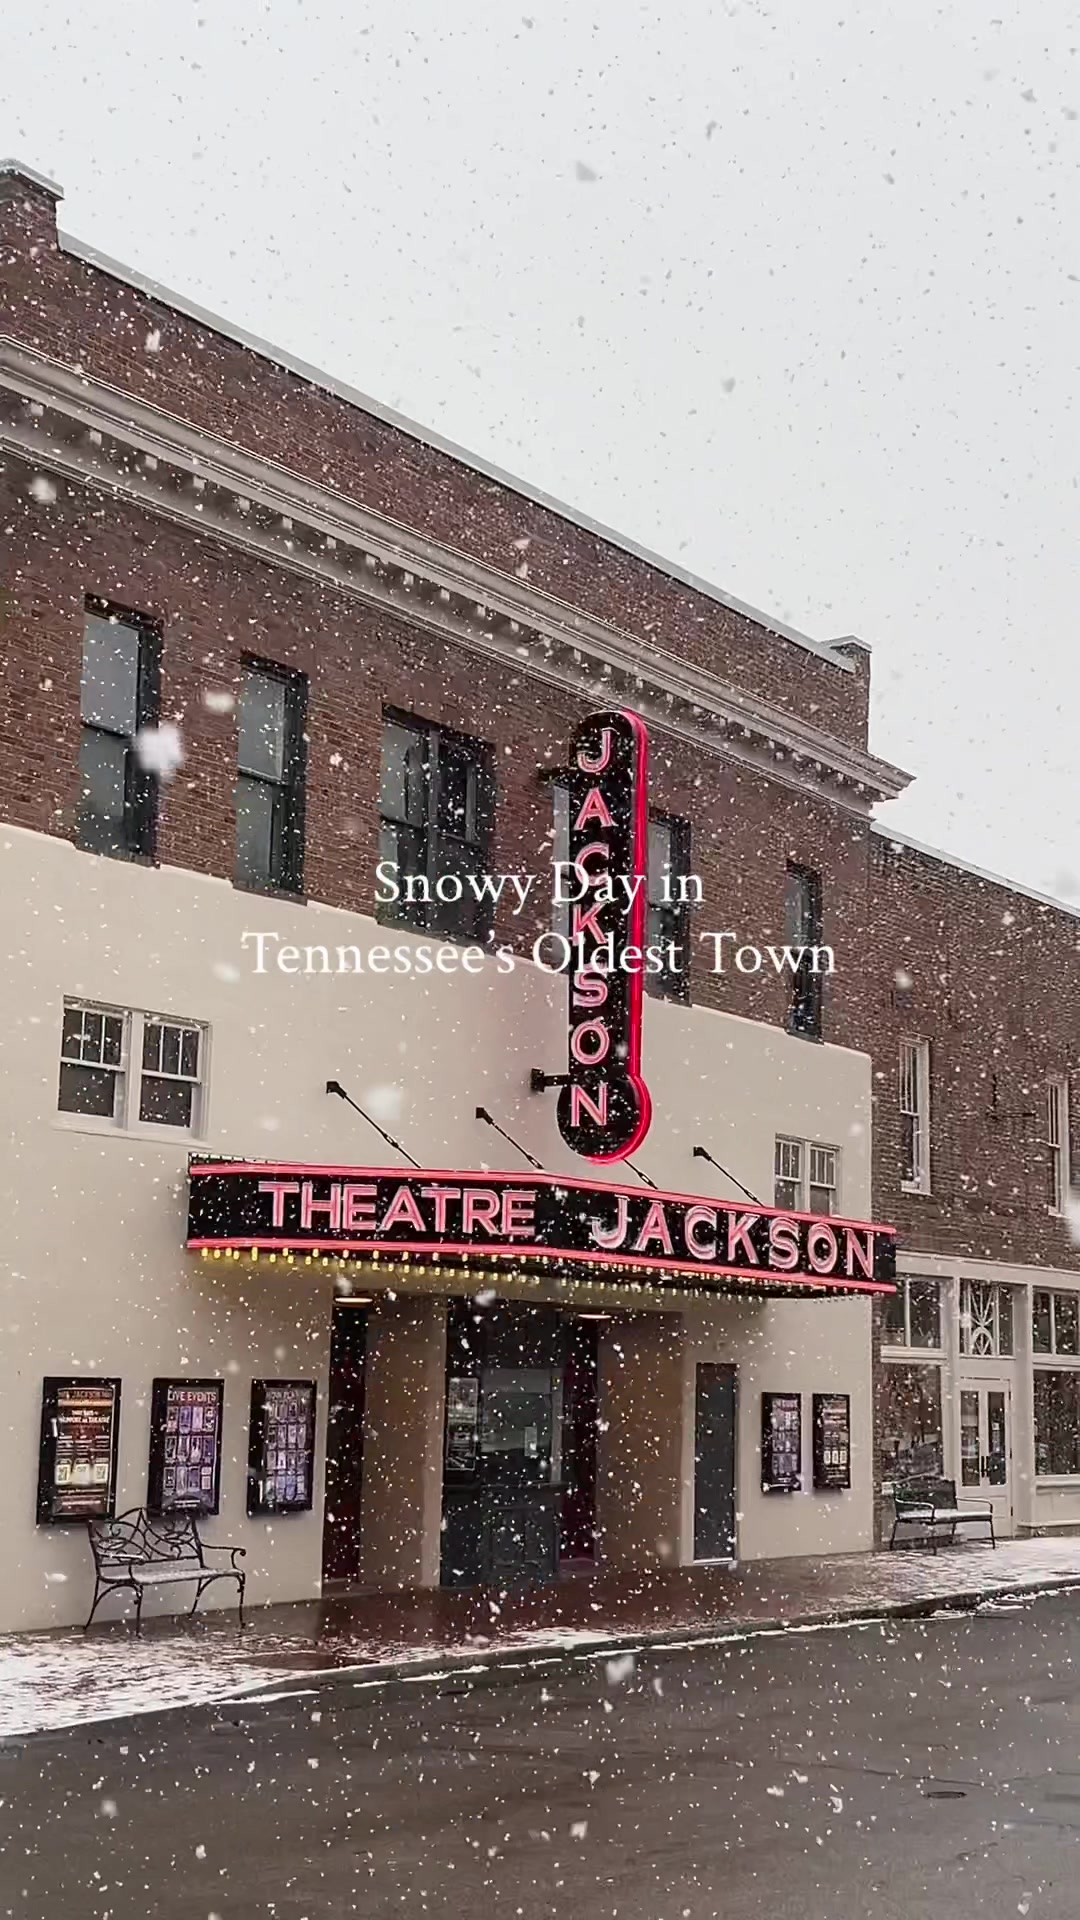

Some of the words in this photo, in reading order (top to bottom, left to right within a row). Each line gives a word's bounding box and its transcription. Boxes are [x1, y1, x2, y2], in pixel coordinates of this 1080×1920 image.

[571, 728, 617, 1127] JACKSON
[258, 1181, 537, 1237] THEATRE
[591, 1194, 875, 1279] JACKSON
